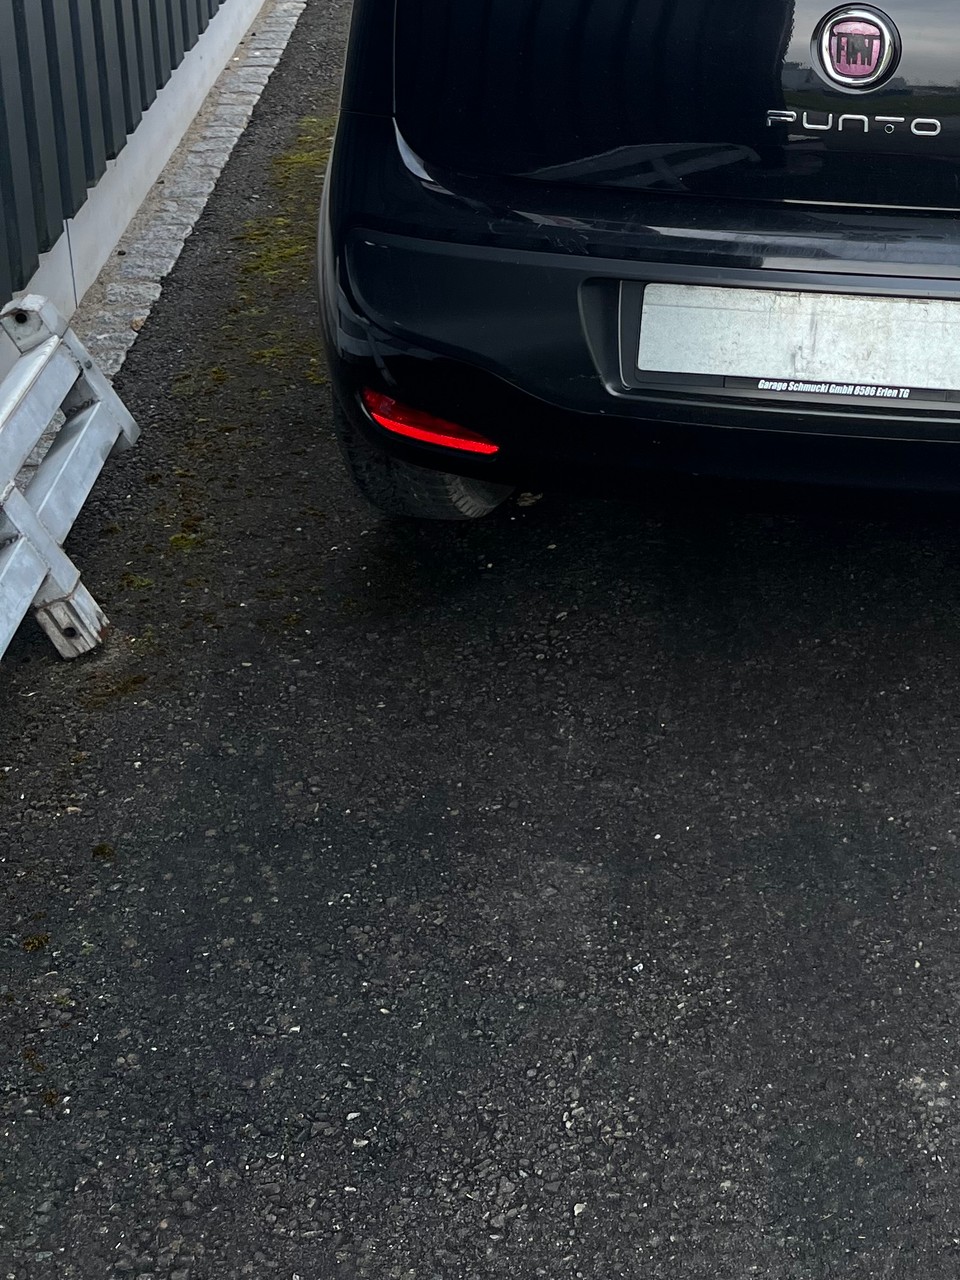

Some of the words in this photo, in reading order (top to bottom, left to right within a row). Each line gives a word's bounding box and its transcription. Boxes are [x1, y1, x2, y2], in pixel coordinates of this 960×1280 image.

[832, 32, 880, 67] FIAT
[766, 109, 942, 136] PUNTO
[757, 379, 788, 392] Garage
[788, 381, 829, 393] Schmucki
[828, 384, 854, 395] GmbH
[853, 385, 876, 396] 8586
[876, 387, 898, 398] Erlen
[898, 388, 911, 399] TG
